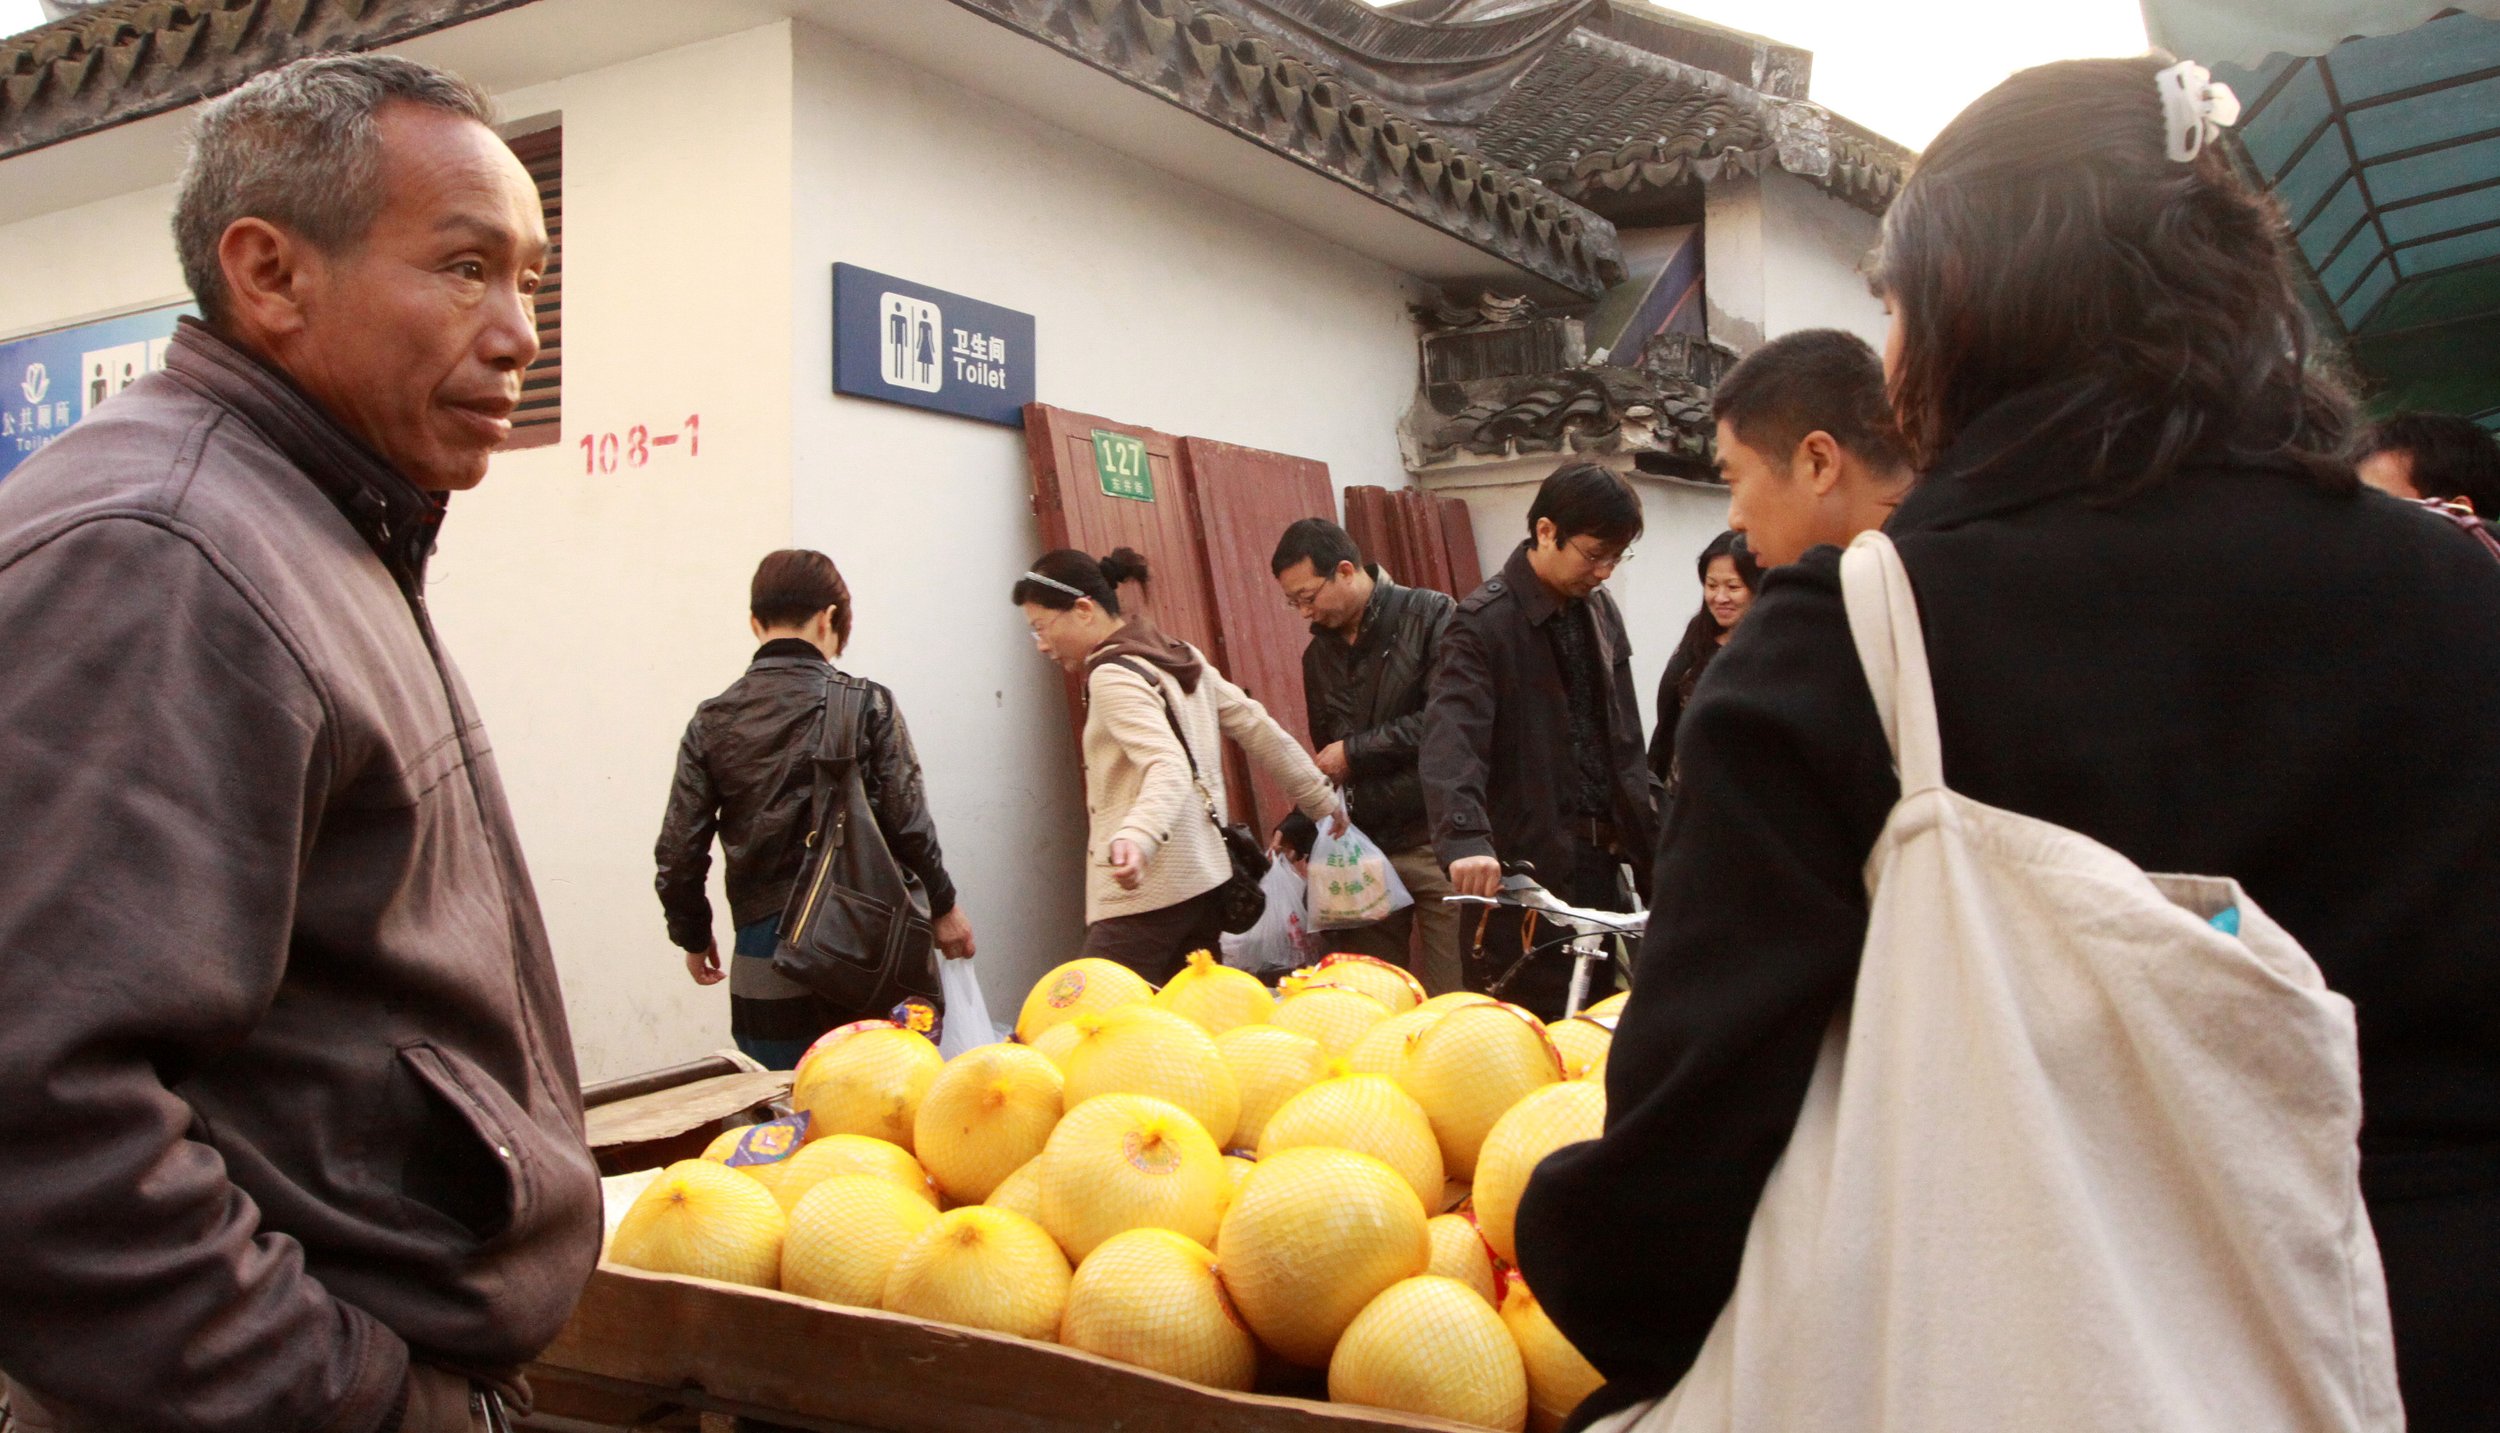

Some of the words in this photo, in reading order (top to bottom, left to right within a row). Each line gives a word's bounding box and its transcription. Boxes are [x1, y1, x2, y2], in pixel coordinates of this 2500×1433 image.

[952, 328, 1006, 364] 卫生间
[953, 356, 1006, 390] Toilet
[580, 413, 699, 475] 108-1
[1102, 439, 1142, 476] 127
